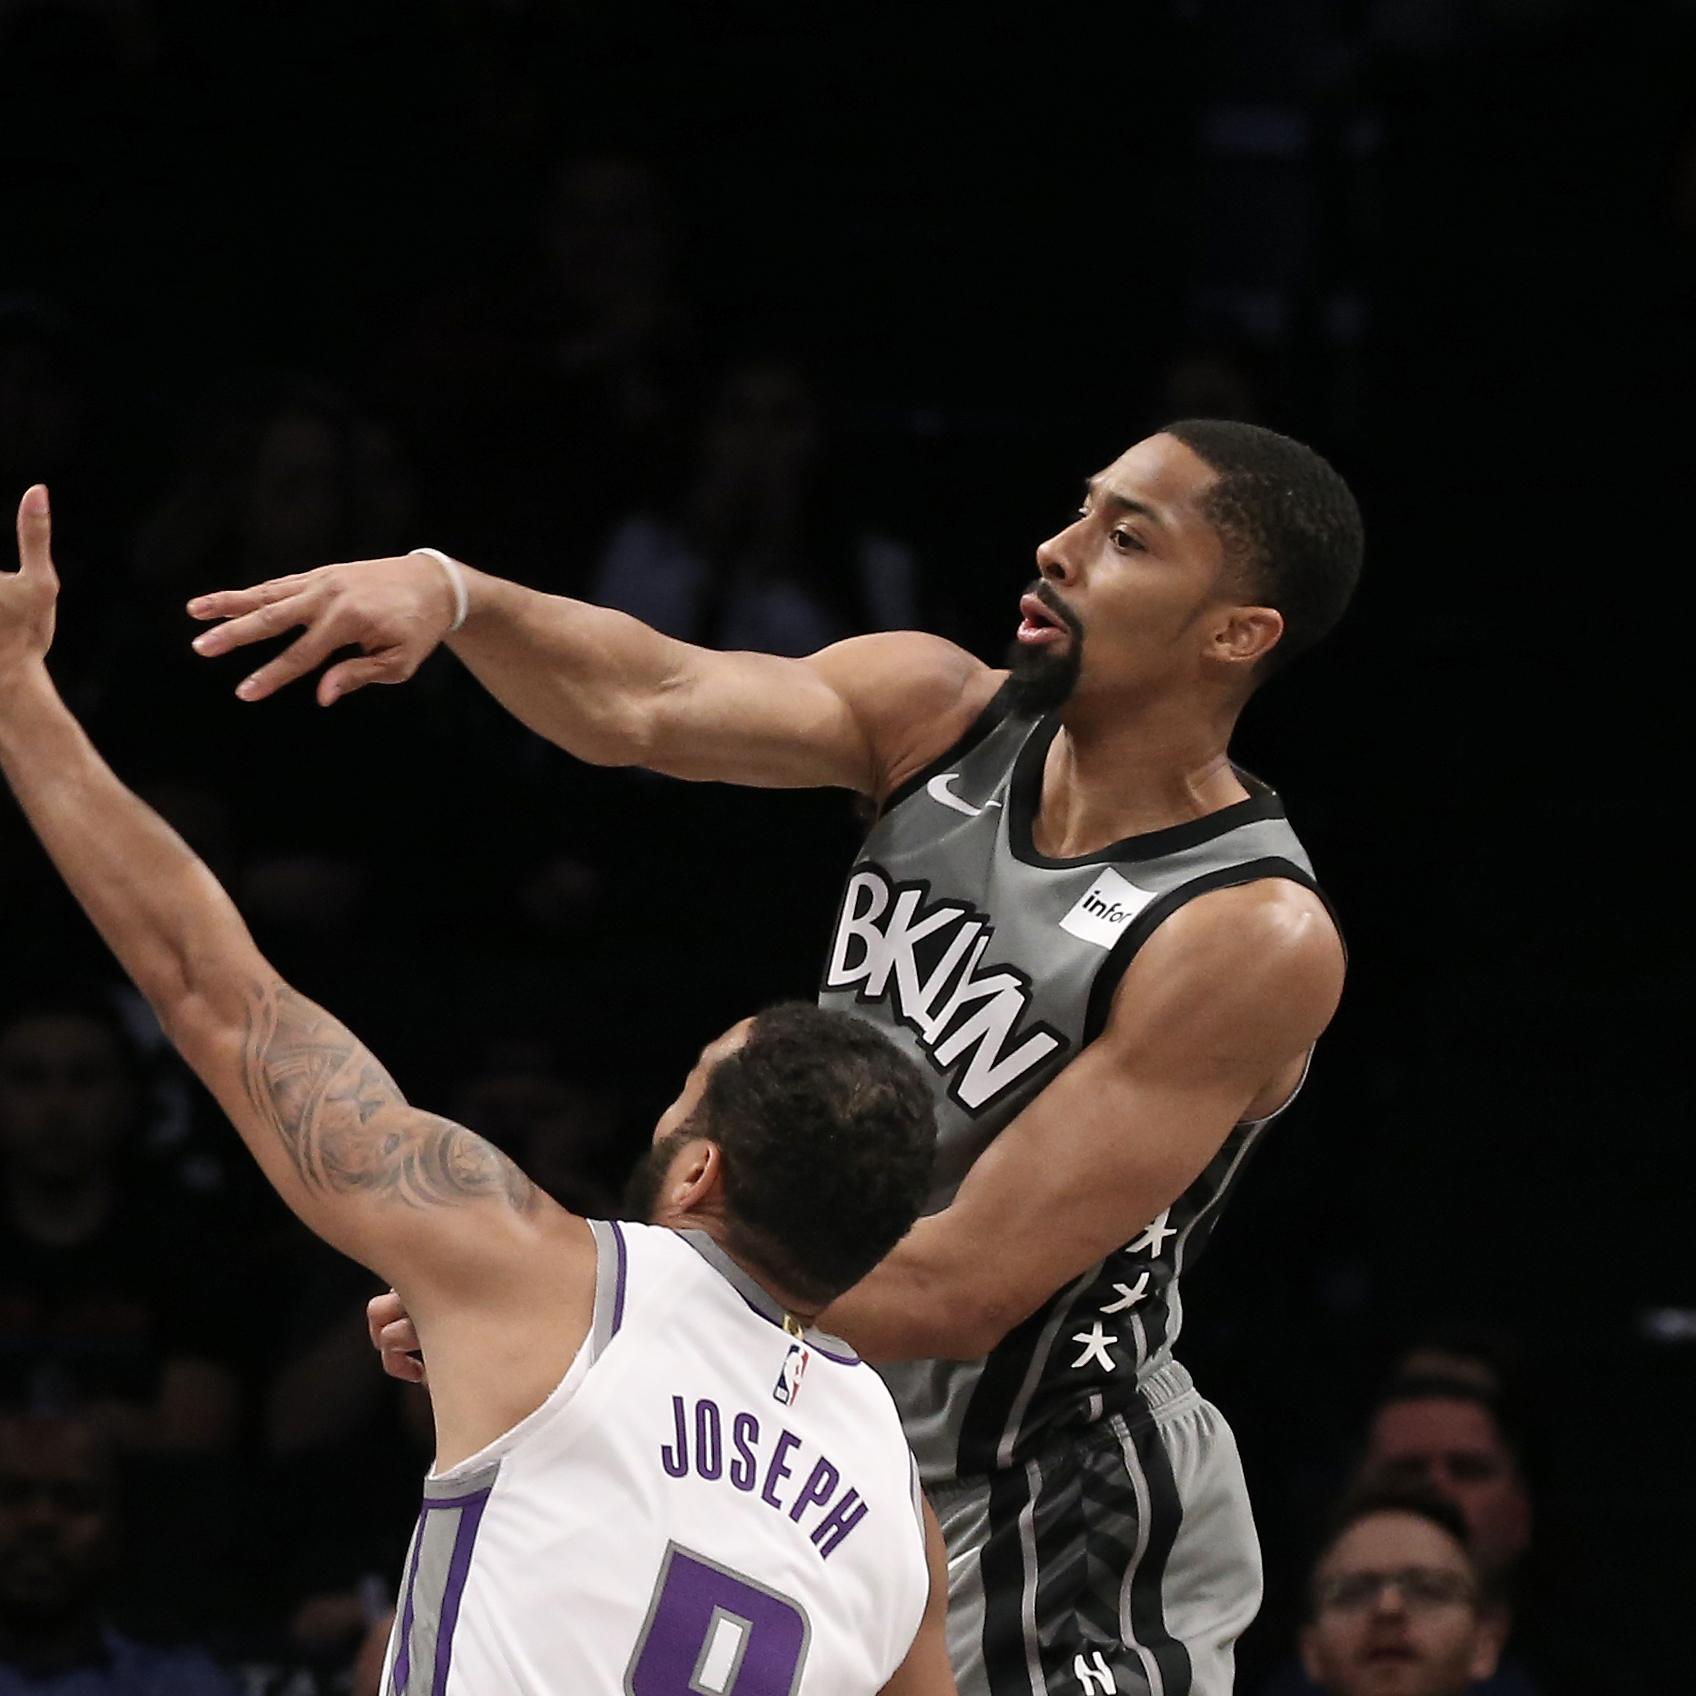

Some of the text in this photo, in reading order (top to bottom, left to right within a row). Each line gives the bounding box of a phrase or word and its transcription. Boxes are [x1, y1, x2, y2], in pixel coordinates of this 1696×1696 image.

[826, 868, 1061, 1111] BKLYN
[1083, 890, 1133, 924] infor
[660, 1394, 870, 1560] JOSEPH
